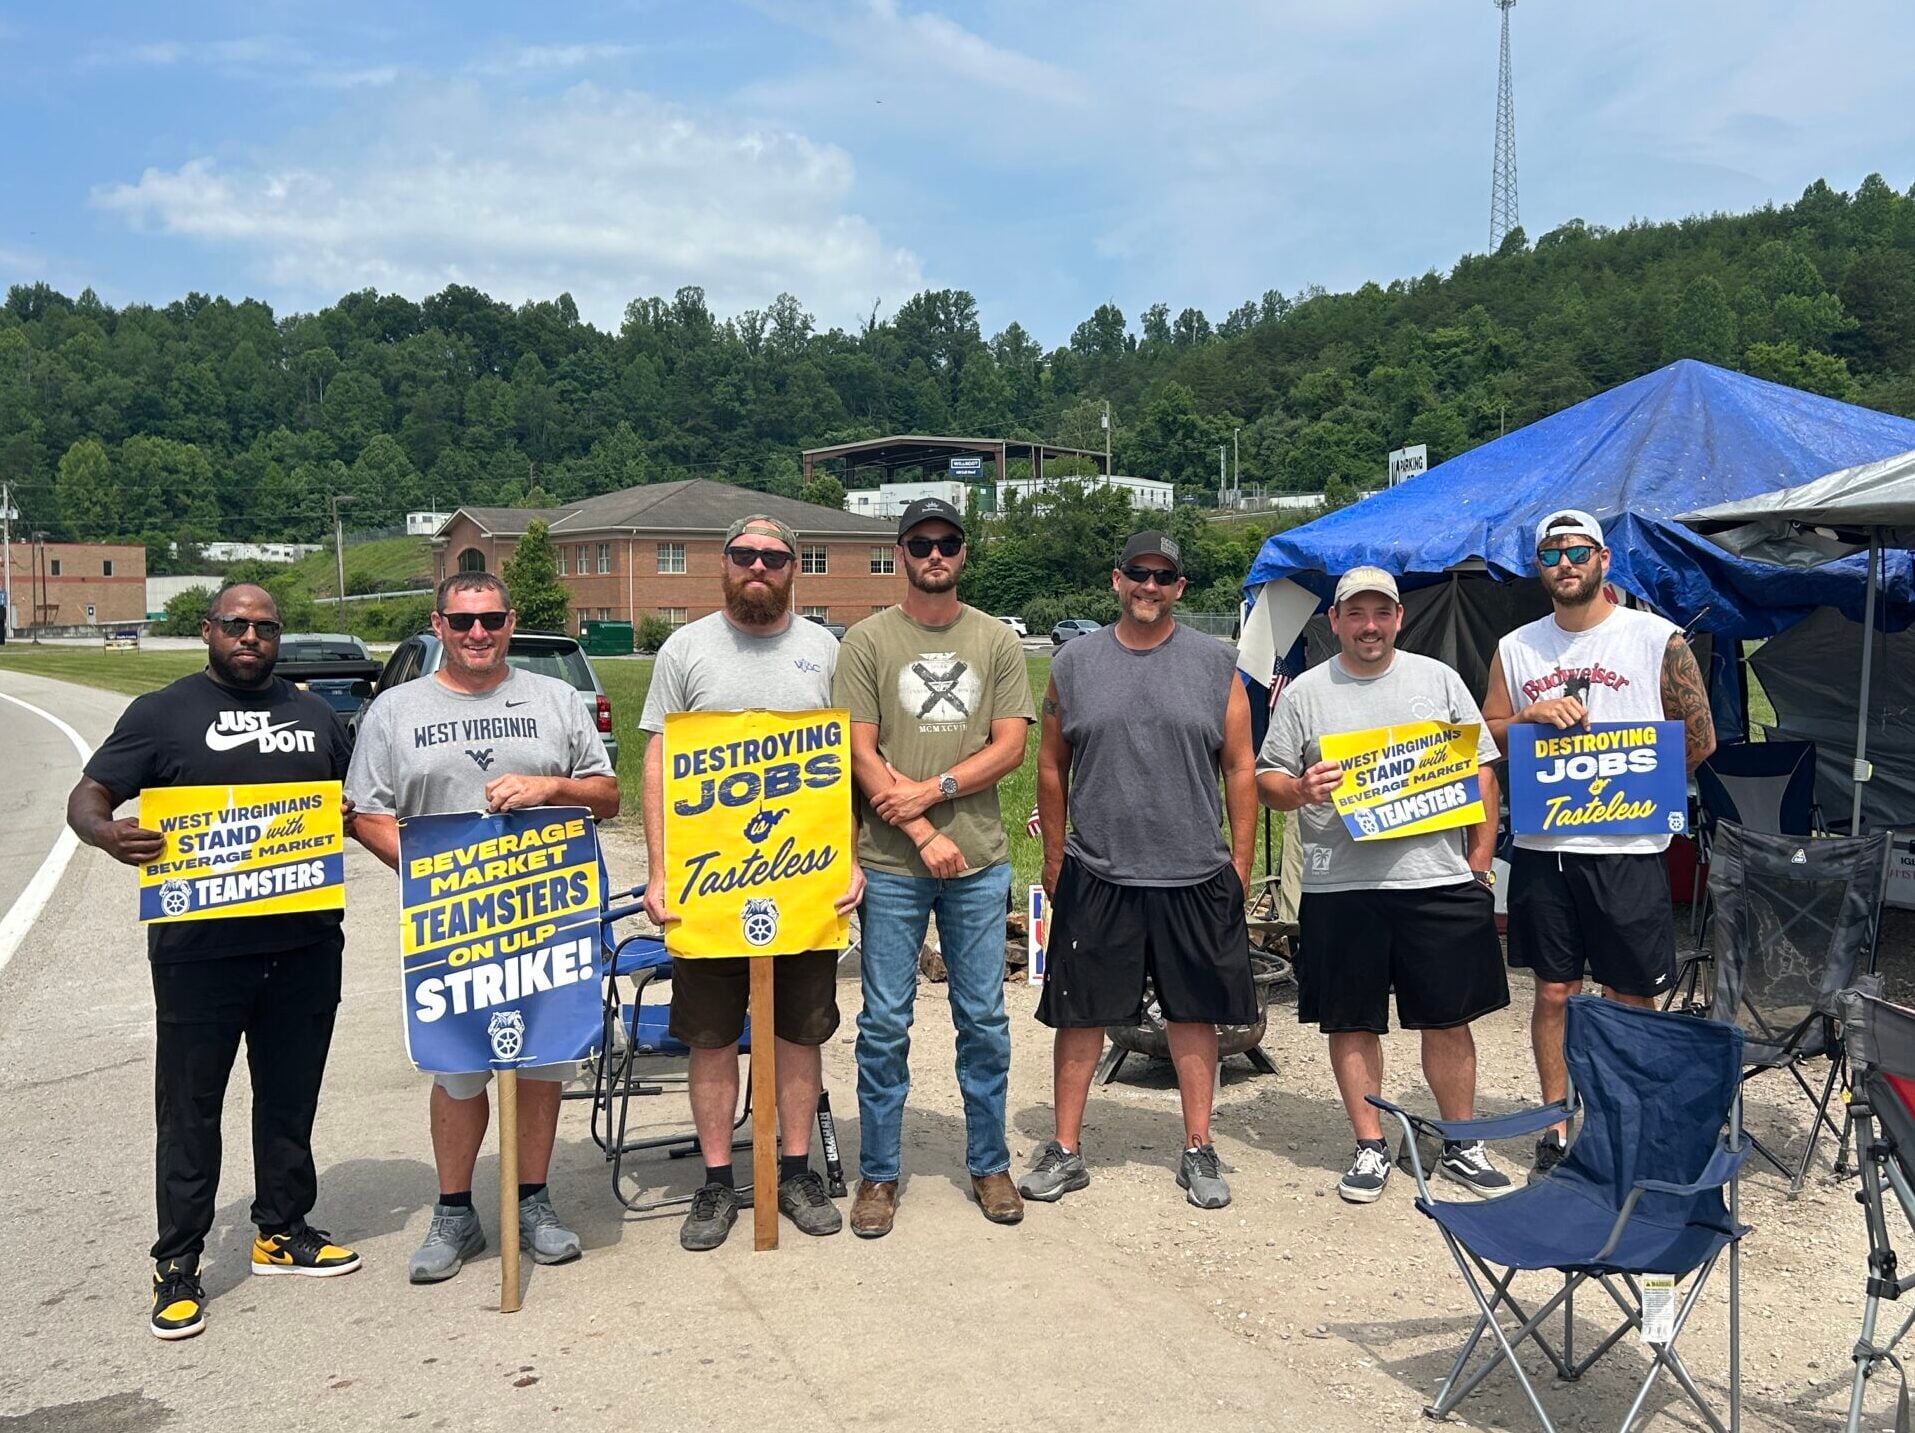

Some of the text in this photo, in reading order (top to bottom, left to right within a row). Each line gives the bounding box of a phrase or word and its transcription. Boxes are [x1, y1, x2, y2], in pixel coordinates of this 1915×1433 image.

[1400, 455, 1423, 471] PARKING
[1522, 662, 1630, 703] Budweiser
[216, 710, 271, 732] JUST
[414, 717, 538, 749] WEST VIRGINIA
[1535, 726, 1657, 758] DESTROYING
[673, 721, 842, 780] DESTROYING
[1340, 729, 1462, 771] WEST VIRGINIANS
[1355, 745, 1448, 787] STAND with
[1536, 748, 1658, 783] JOBS
[673, 753, 842, 817] JOBS
[1338, 759, 1472, 807] BEVERAGE MARKET
[160, 794, 322, 833] WEST VIRGINIANS
[750, 813, 769, 835] is
[1374, 782, 1467, 828] TEAMSTERS
[1542, 790, 1657, 831] Tasteless
[146, 834, 335, 876] BEVERAGE MARKET
[178, 814, 305, 854] STAND with
[410, 819, 585, 879] BEVERAGE
[195, 860, 325, 906] TEAMSTERS
[430, 844, 567, 897] MARKET
[679, 836, 839, 905] Tasteless
[411, 870, 589, 947] TEAMSTERS
[448, 924, 557, 967] ON ULP
[415, 937, 594, 1023] STRIKE!
